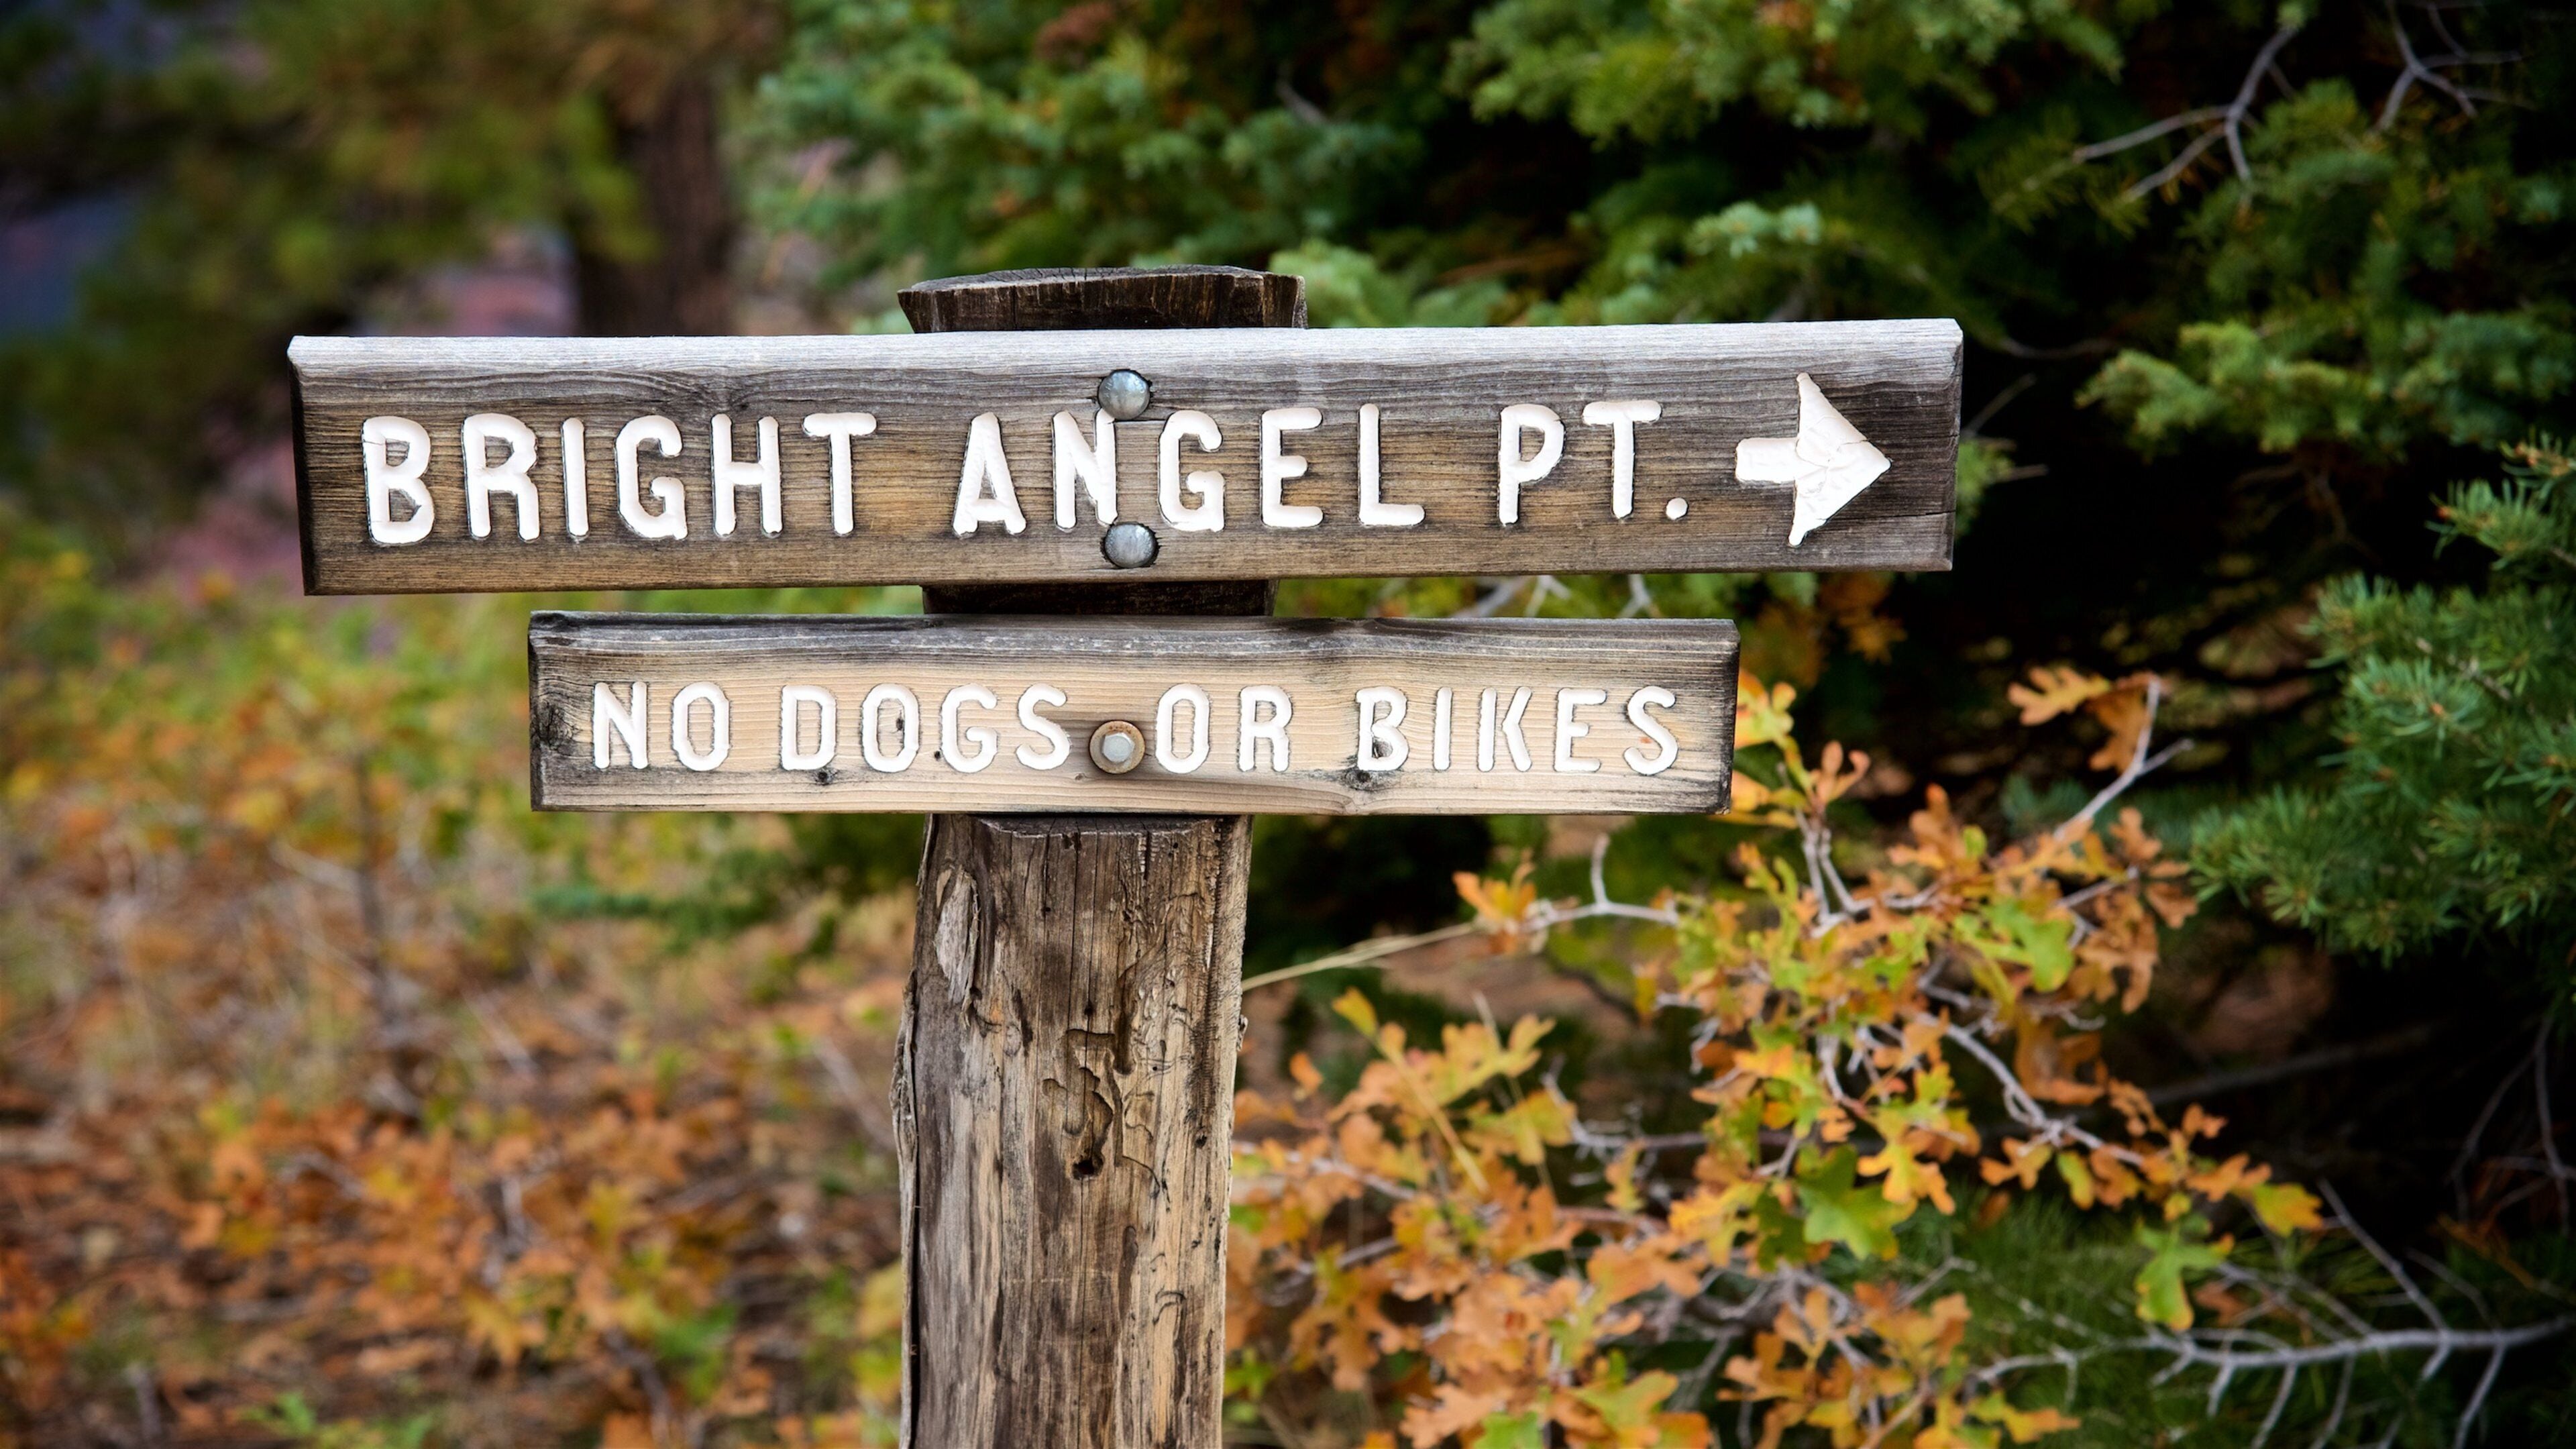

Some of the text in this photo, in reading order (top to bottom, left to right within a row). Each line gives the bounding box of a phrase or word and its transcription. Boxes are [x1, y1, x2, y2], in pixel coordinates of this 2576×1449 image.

[361, 399, 1689, 544] BRIGHT ANGEL PT.
[592, 681, 1680, 776] NO DOGS OR BIKES
